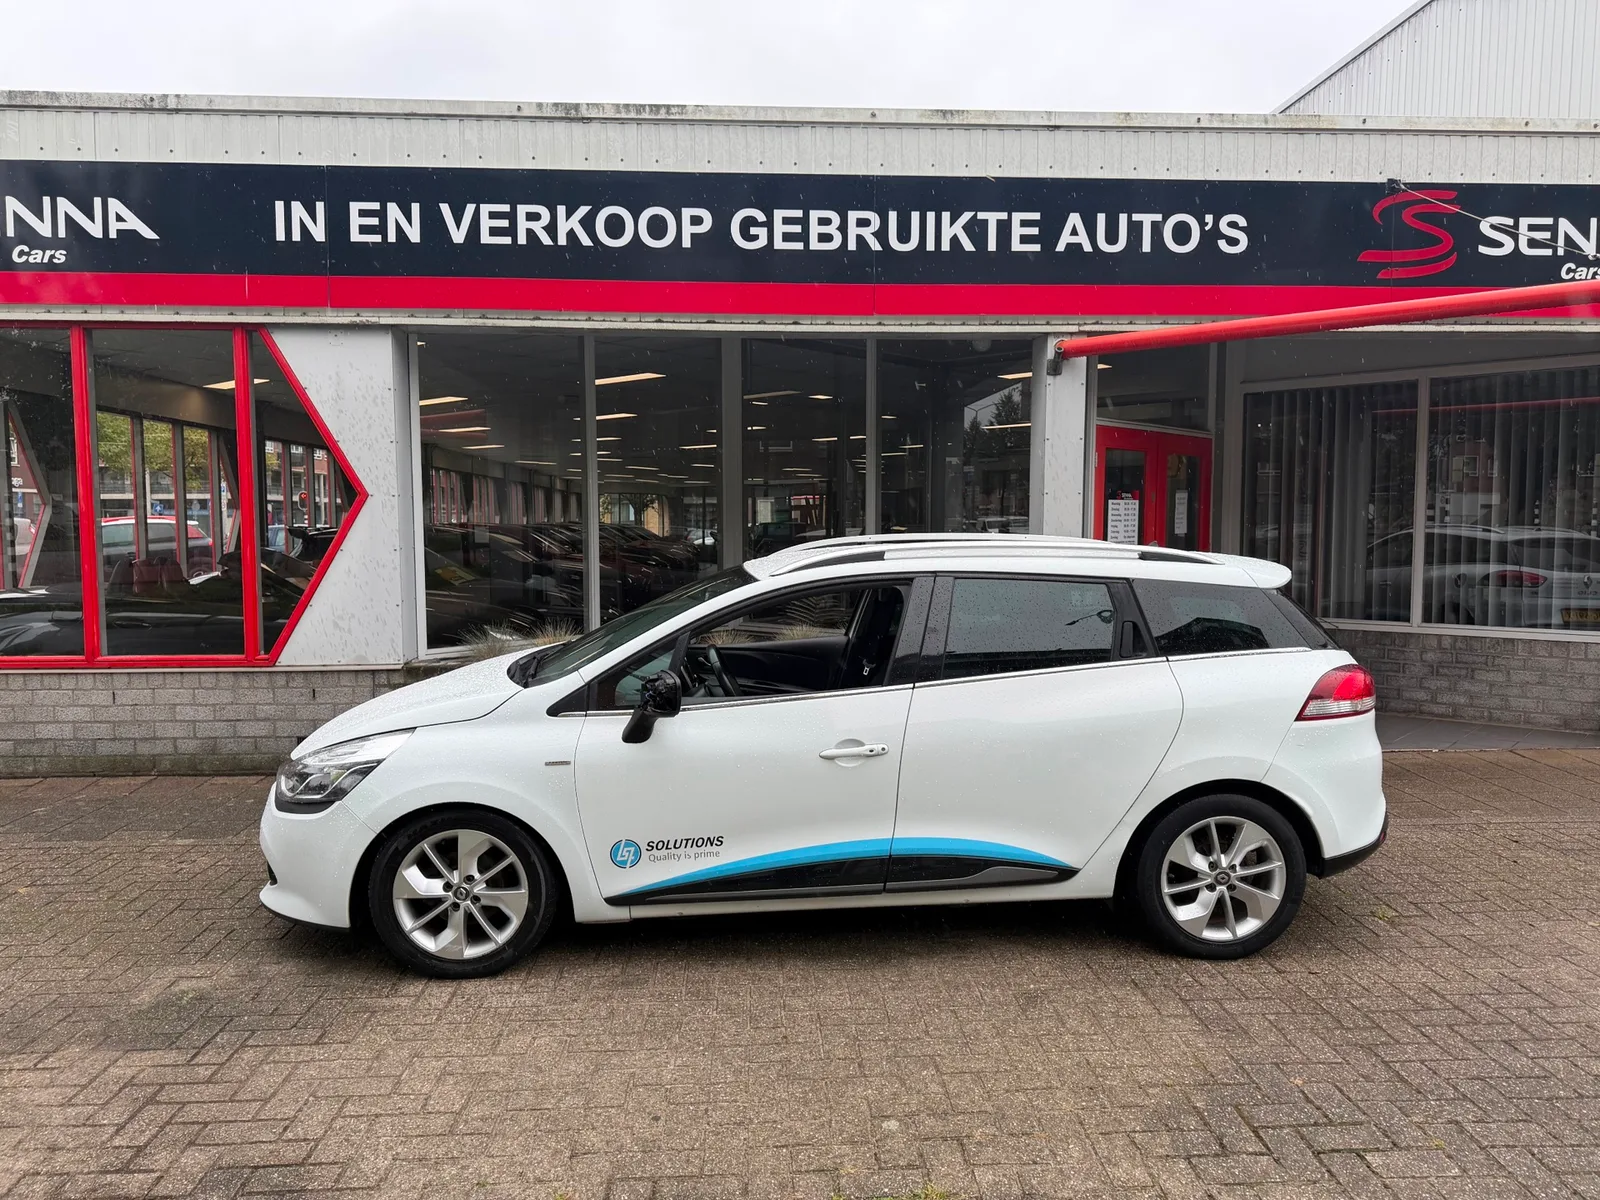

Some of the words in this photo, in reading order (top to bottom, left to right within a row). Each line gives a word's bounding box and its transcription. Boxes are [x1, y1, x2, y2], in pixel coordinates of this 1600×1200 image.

[275, 201, 326, 242] IN
[350, 202, 421, 243] EN
[439, 203, 713, 249] VERKOOP
[731, 208, 1041, 252] GEBRUIKTE
[1055, 213, 1249, 254] AUTO’S
[1478, 216, 1598, 256] SEN
[12, 245, 67, 263] Cars
[646, 836, 724, 851] SOLUTIONS
[648, 850, 682, 863] Quality
[684, 850, 692, 860] is
[694, 849, 721, 861] prime
